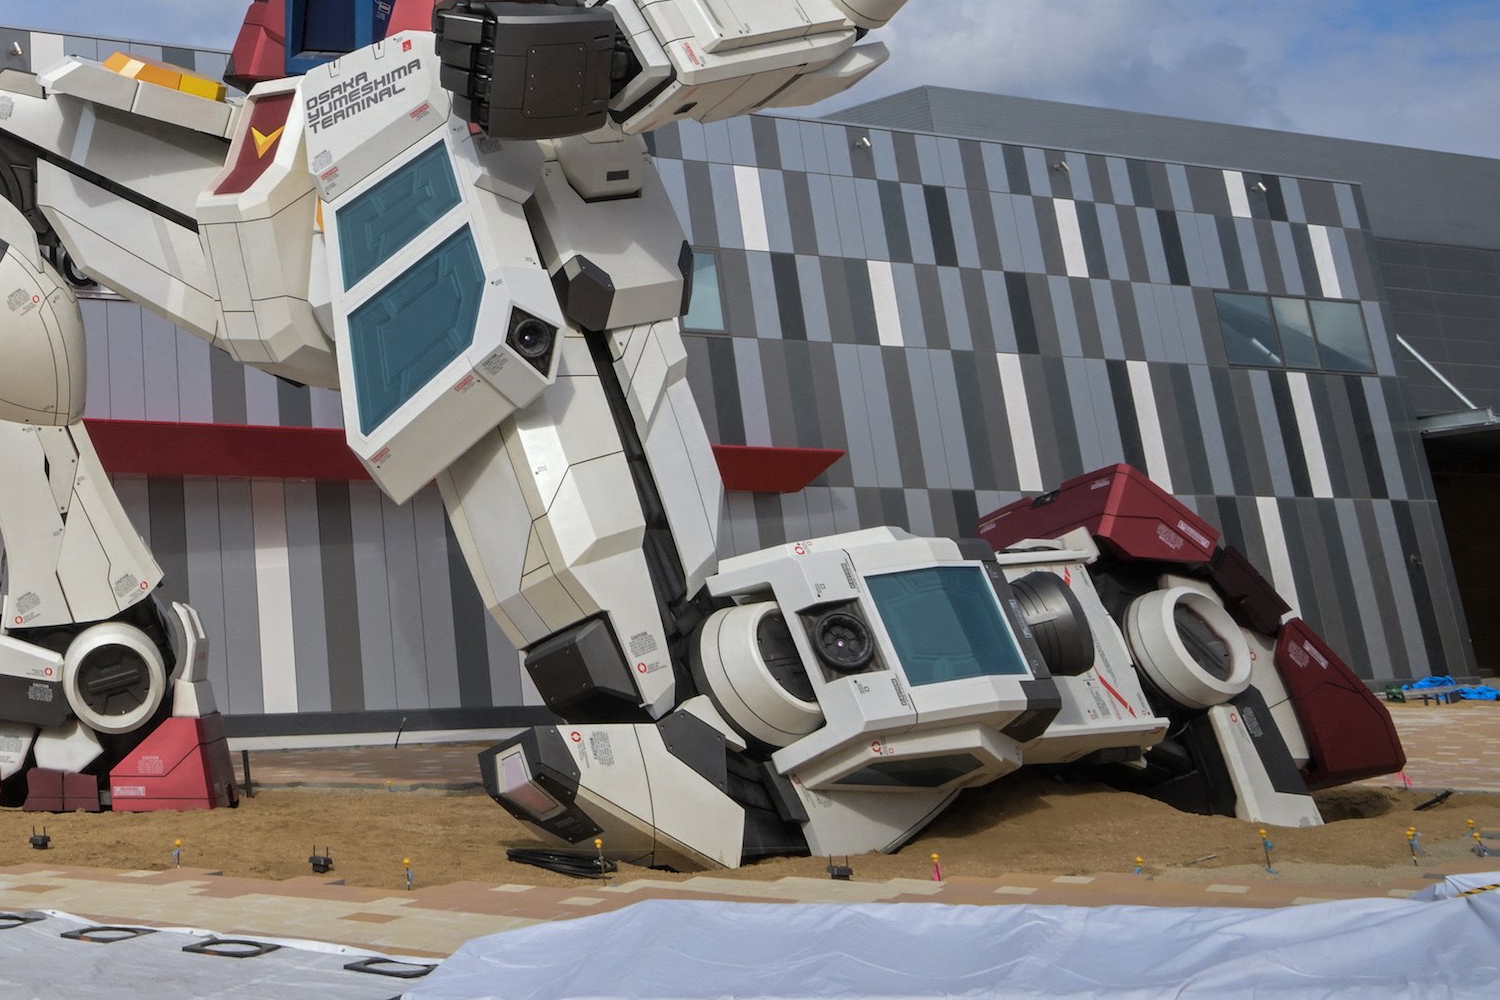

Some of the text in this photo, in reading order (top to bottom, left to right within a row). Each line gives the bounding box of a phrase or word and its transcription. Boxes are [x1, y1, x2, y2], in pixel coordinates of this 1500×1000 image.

[306, 71, 369, 112] OSAKA
[308, 58, 422, 124] YUMESHIMA
[309, 86, 406, 135] TERMINAL
